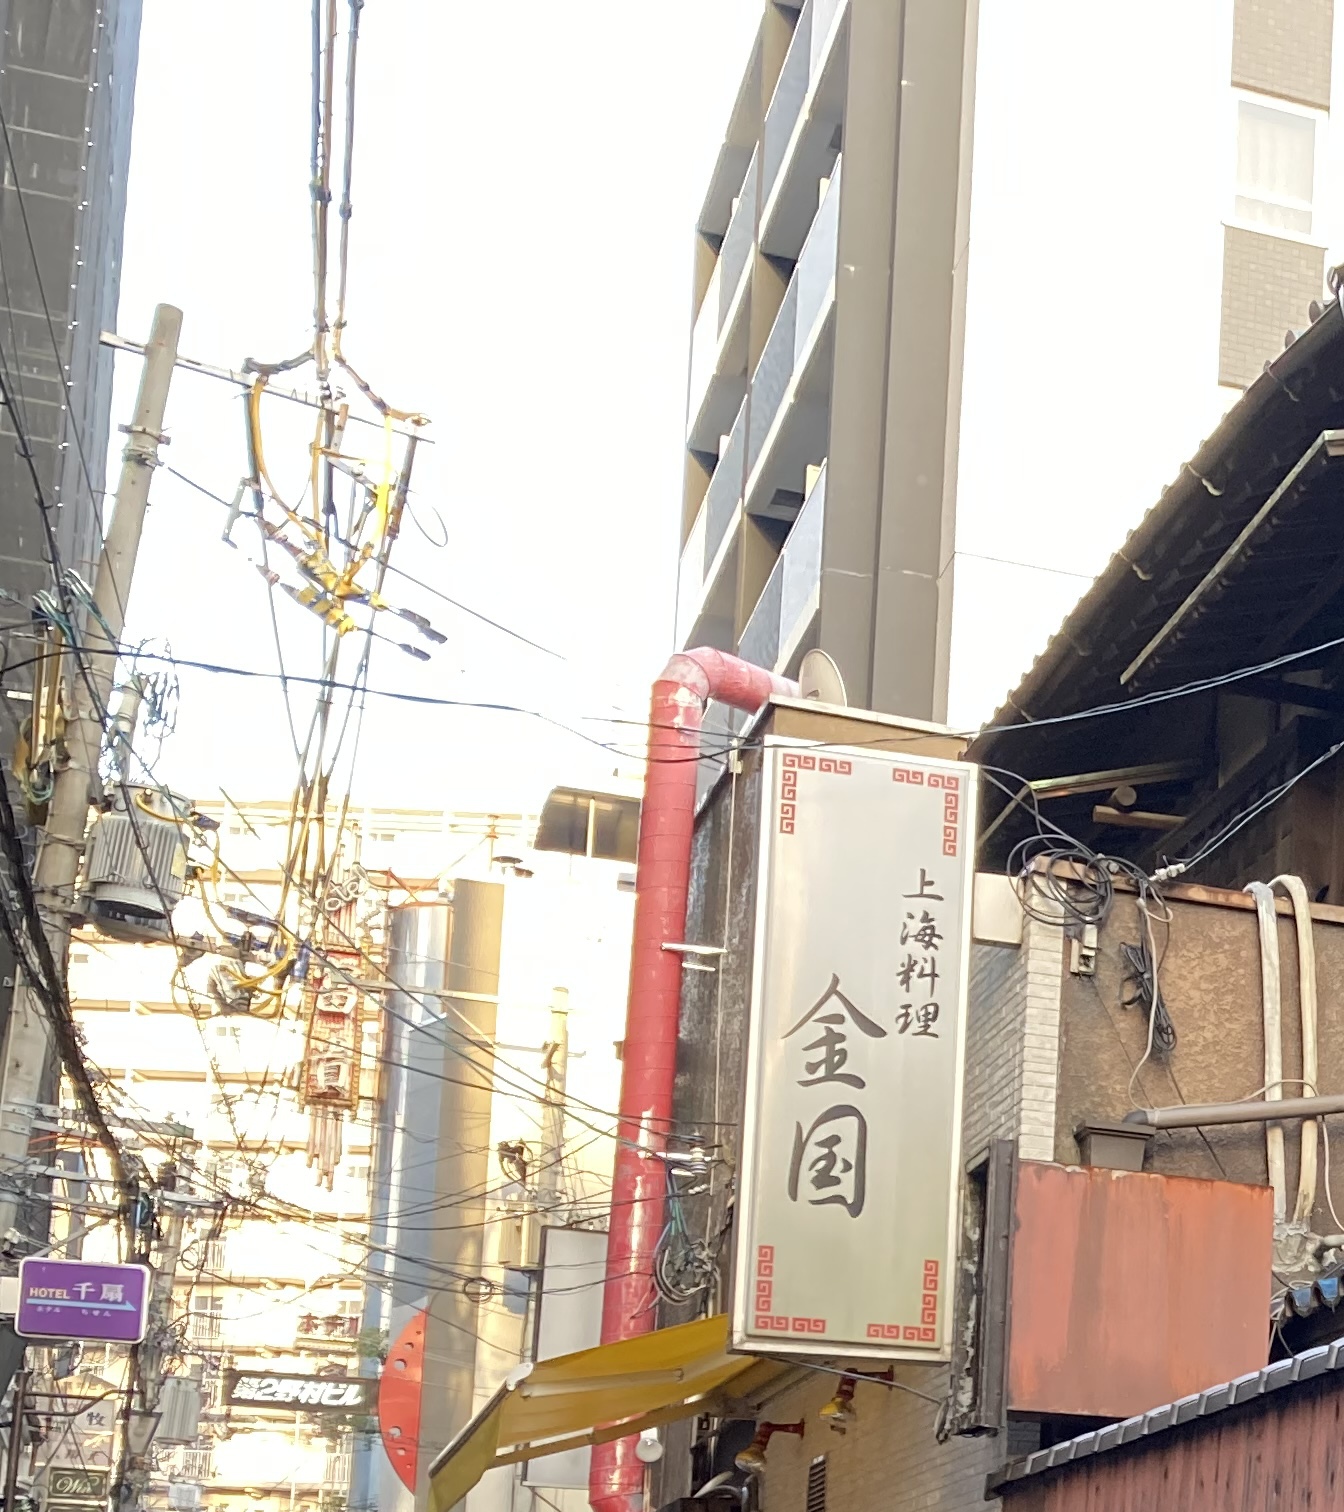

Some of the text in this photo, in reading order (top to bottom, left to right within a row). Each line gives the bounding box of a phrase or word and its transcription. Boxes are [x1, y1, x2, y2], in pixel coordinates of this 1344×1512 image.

[894, 867, 945, 1041] 上海料理
[781, 972, 887, 1219] 金国
[29, 1287, 71, 1300] HOTEL
